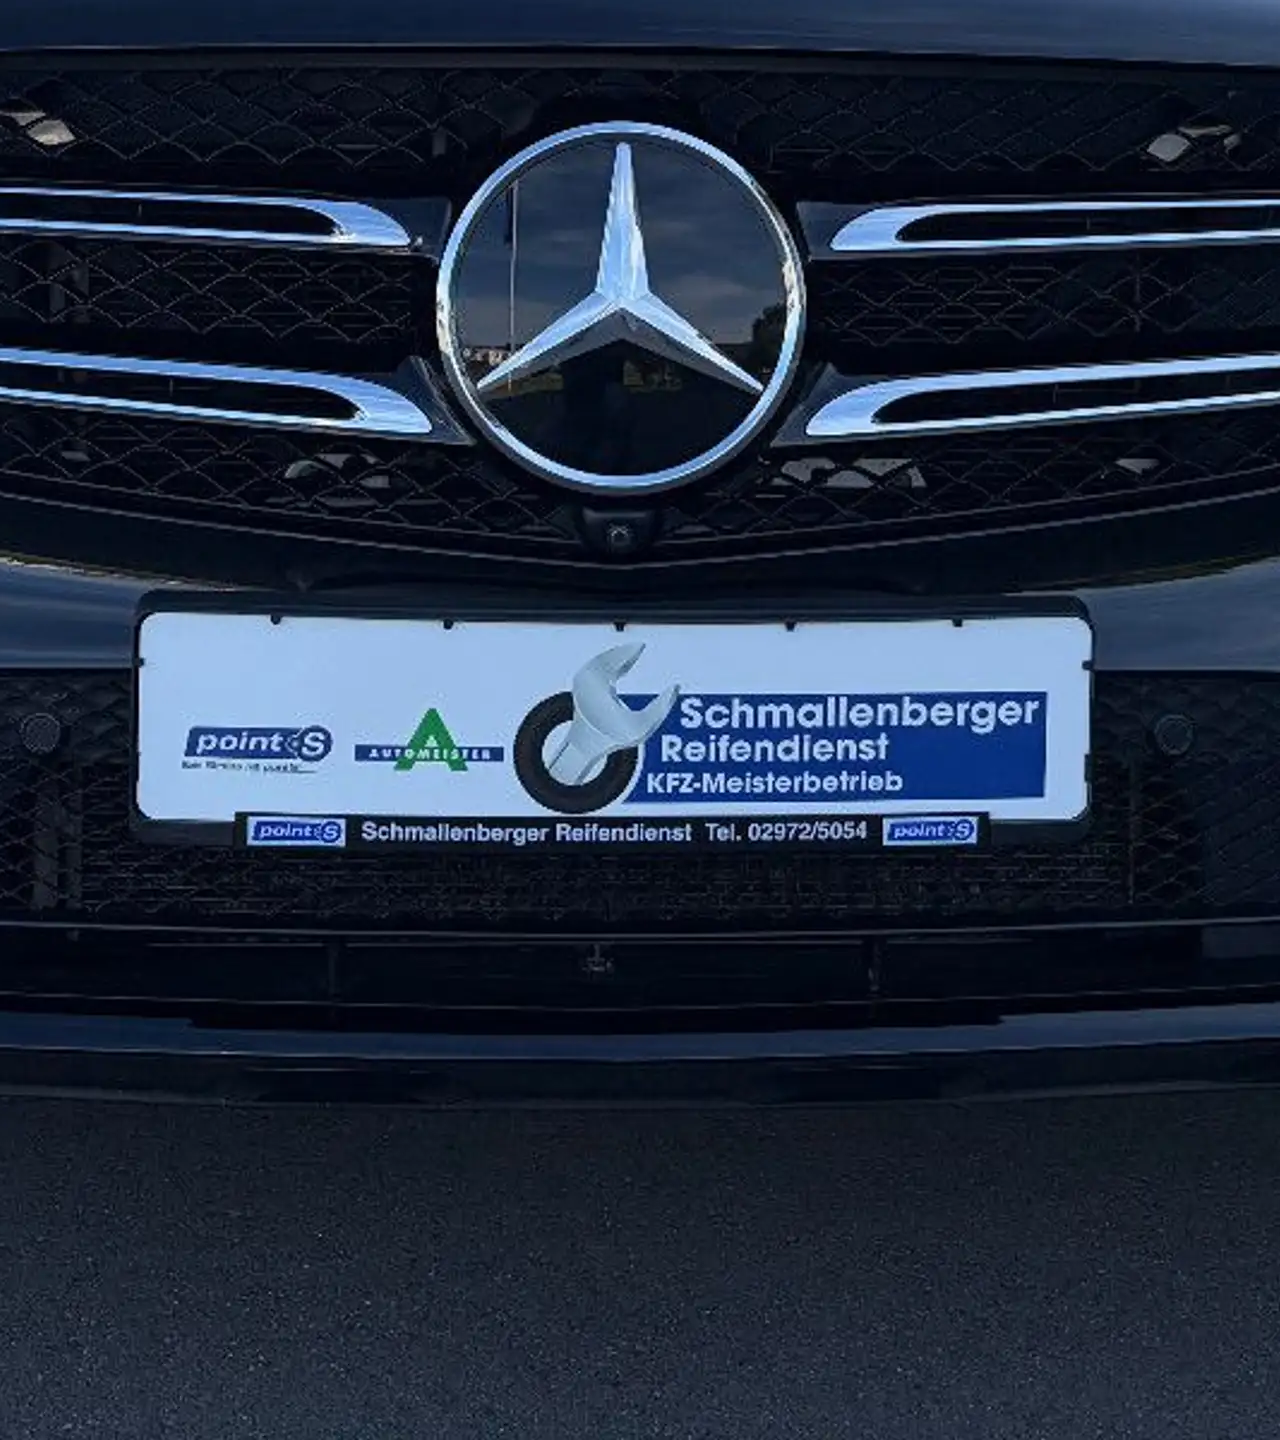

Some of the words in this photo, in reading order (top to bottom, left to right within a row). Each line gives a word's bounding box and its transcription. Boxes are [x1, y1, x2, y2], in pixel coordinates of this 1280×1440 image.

[680, 696, 1040, 734] Schmallenberger
[369, 748, 491, 760] AUTOMEISTER
[661, 733, 889, 762] Reifendienst
[647, 770, 903, 794] KFZ-Meisterbetrieb
[361, 821, 549, 846] Schmallenberger
[555, 822, 692, 841] Reifendienst
[705, 823, 742, 841] Tel.
[747, 821, 868, 842] 02972/5054
